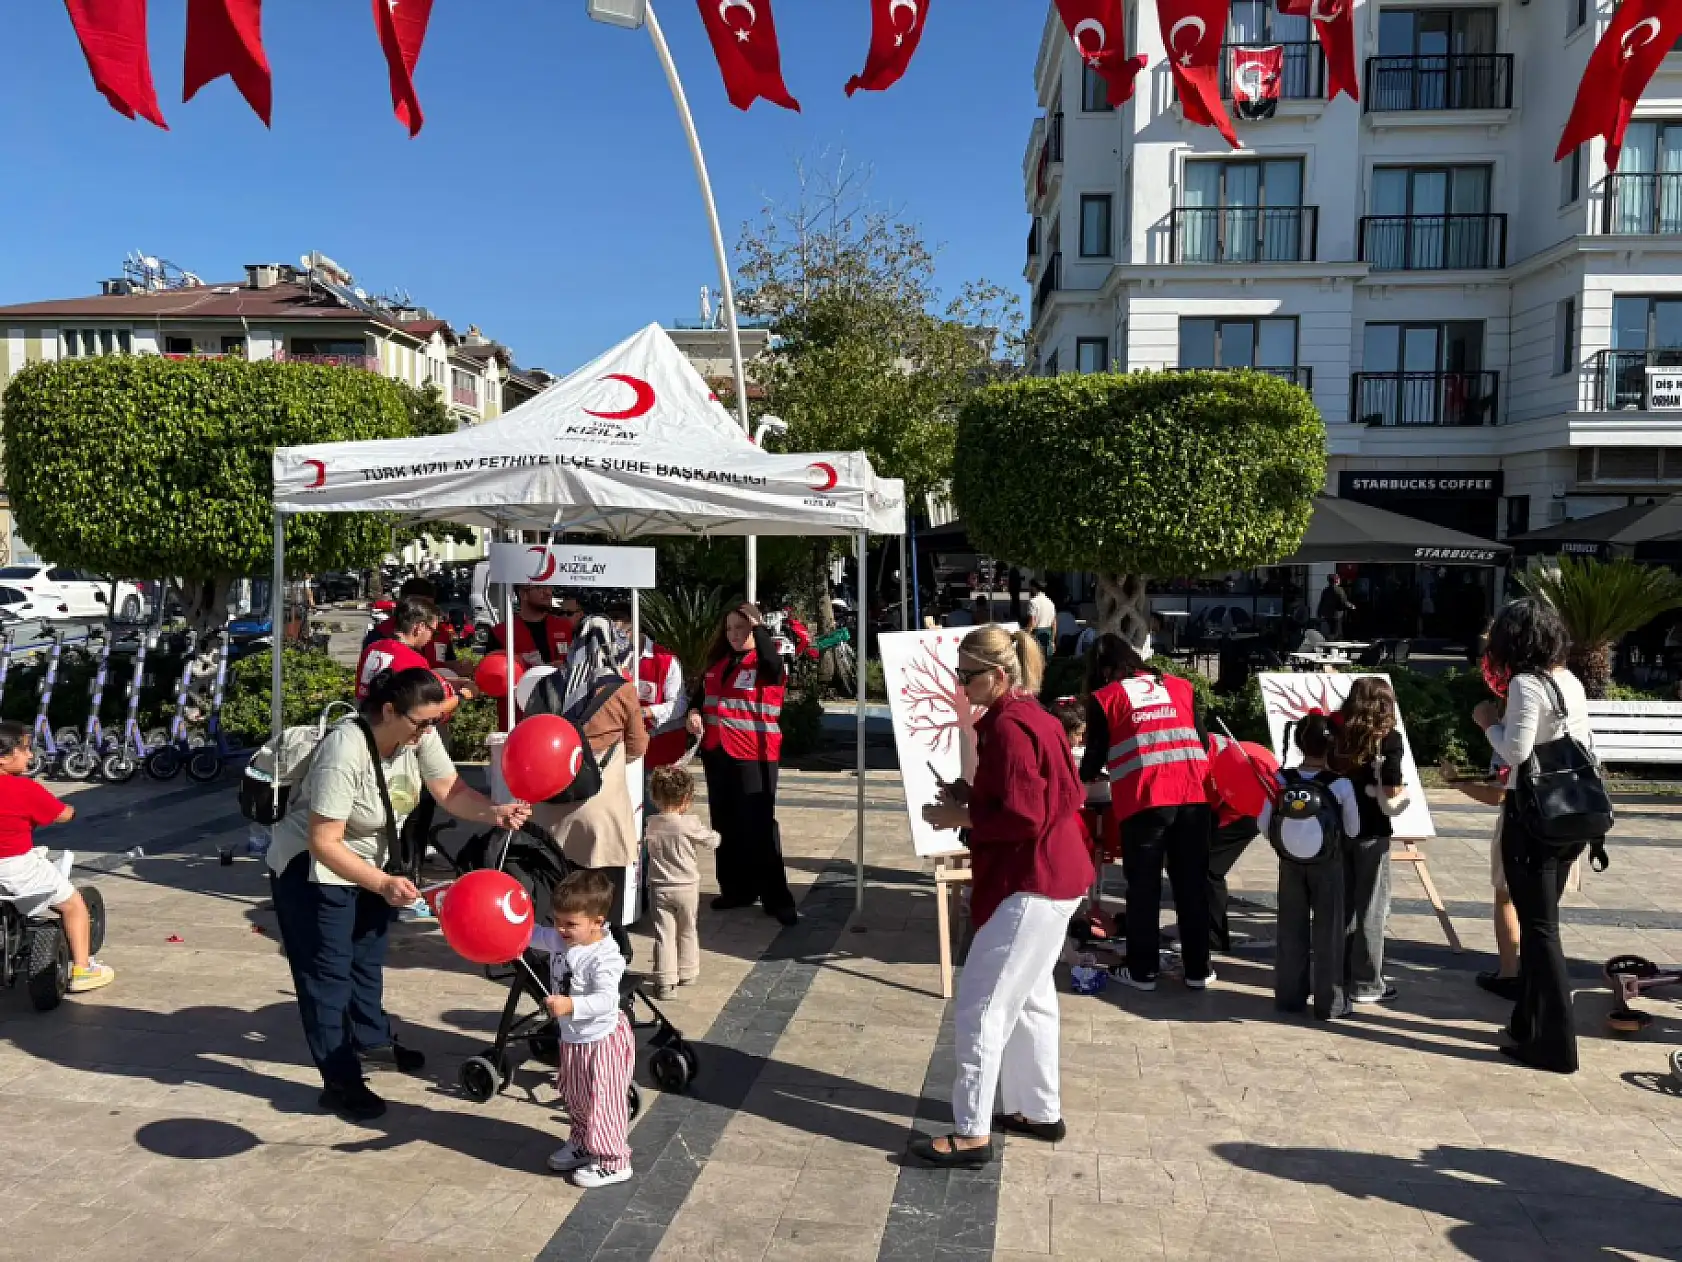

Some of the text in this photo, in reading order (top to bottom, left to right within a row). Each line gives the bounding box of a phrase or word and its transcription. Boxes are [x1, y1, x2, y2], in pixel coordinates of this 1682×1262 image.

[1655, 379, 1674, 392] DİŞ
[1652, 395, 1681, 407] ORHAN
[360, 467, 408, 482] TÜRK
[1352, 478, 1493, 490] STARBUCKS COFFEE
[1414, 547, 1497, 560] STARBUCKS
[559, 562, 608, 575] KIZILAY
